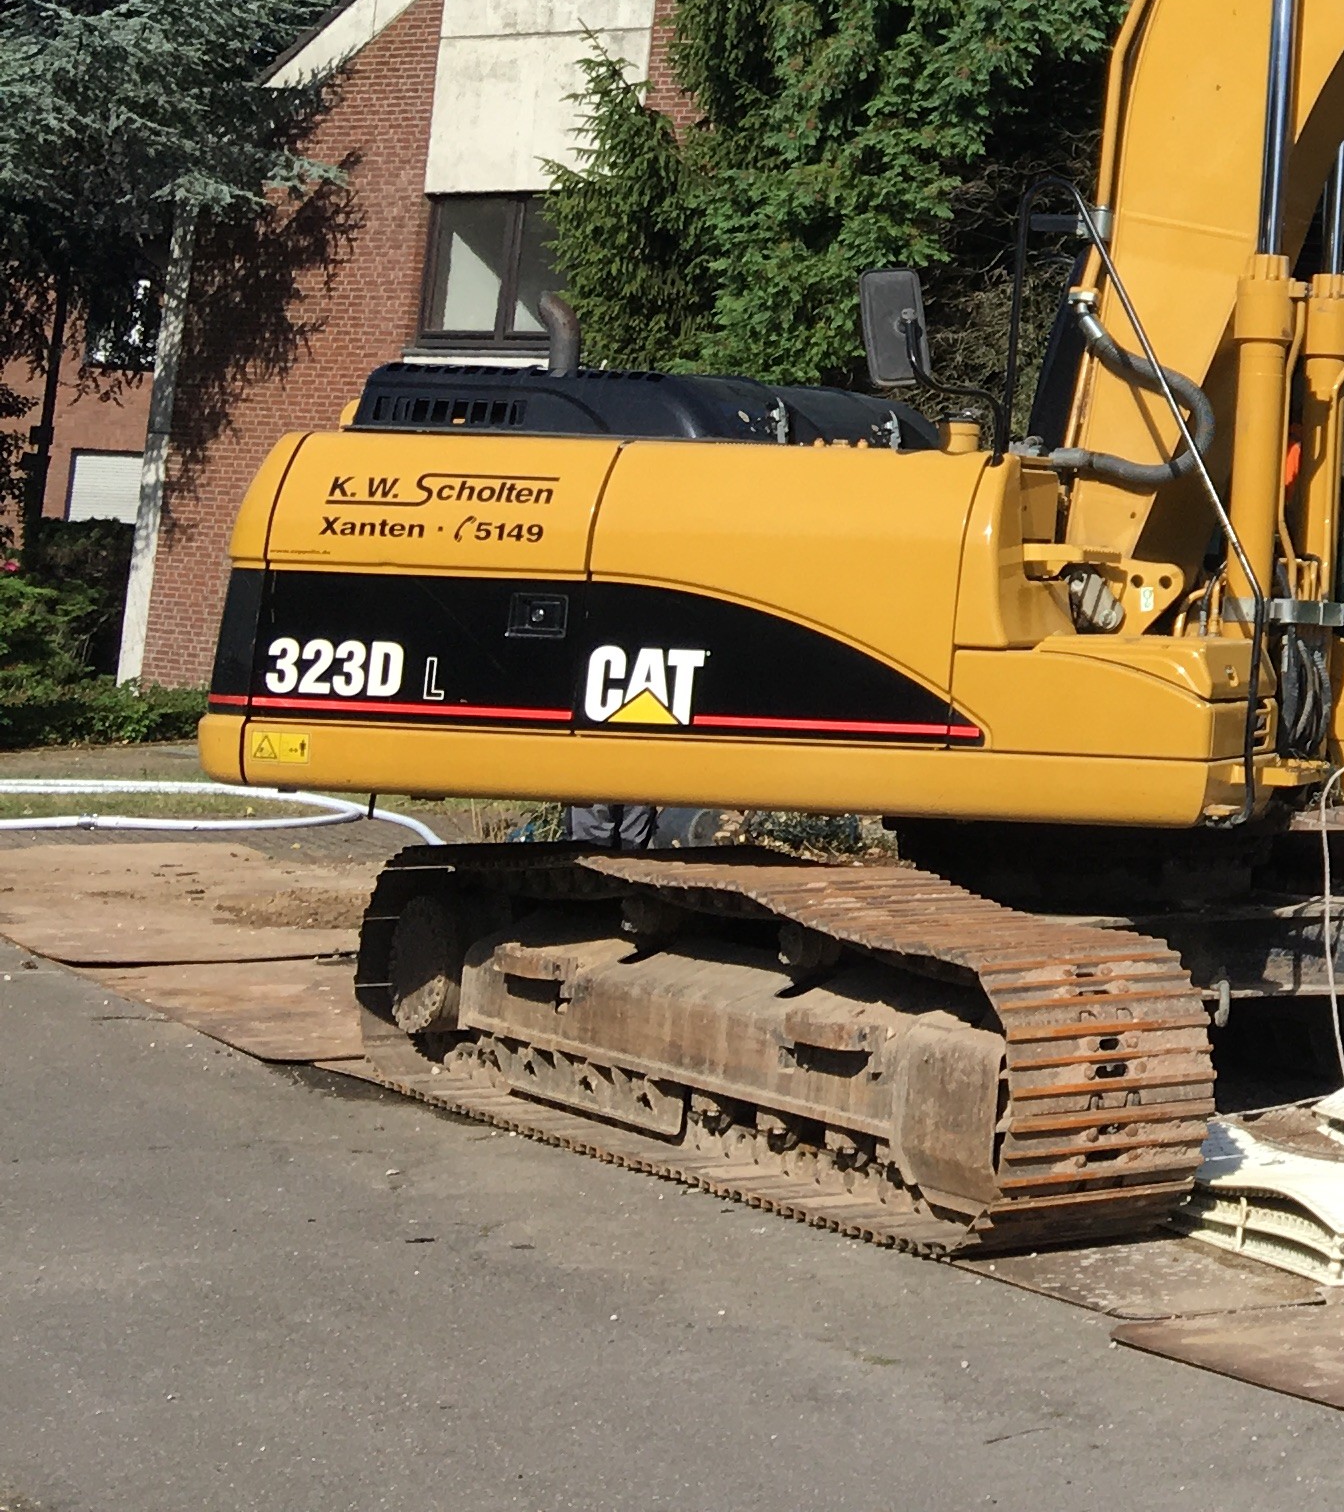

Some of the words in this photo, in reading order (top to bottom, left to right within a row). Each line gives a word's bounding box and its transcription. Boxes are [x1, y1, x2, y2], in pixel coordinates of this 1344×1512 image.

[328, 476, 357, 498] K.
[367, 476, 401, 499] W.
[415, 473, 560, 507] Scholten
[319, 516, 425, 539] Xanten
[474, 522, 544, 543] 5149
[265, 638, 405, 697] 323D
[423, 657, 445, 701] L
[585, 645, 705, 725] CAT
